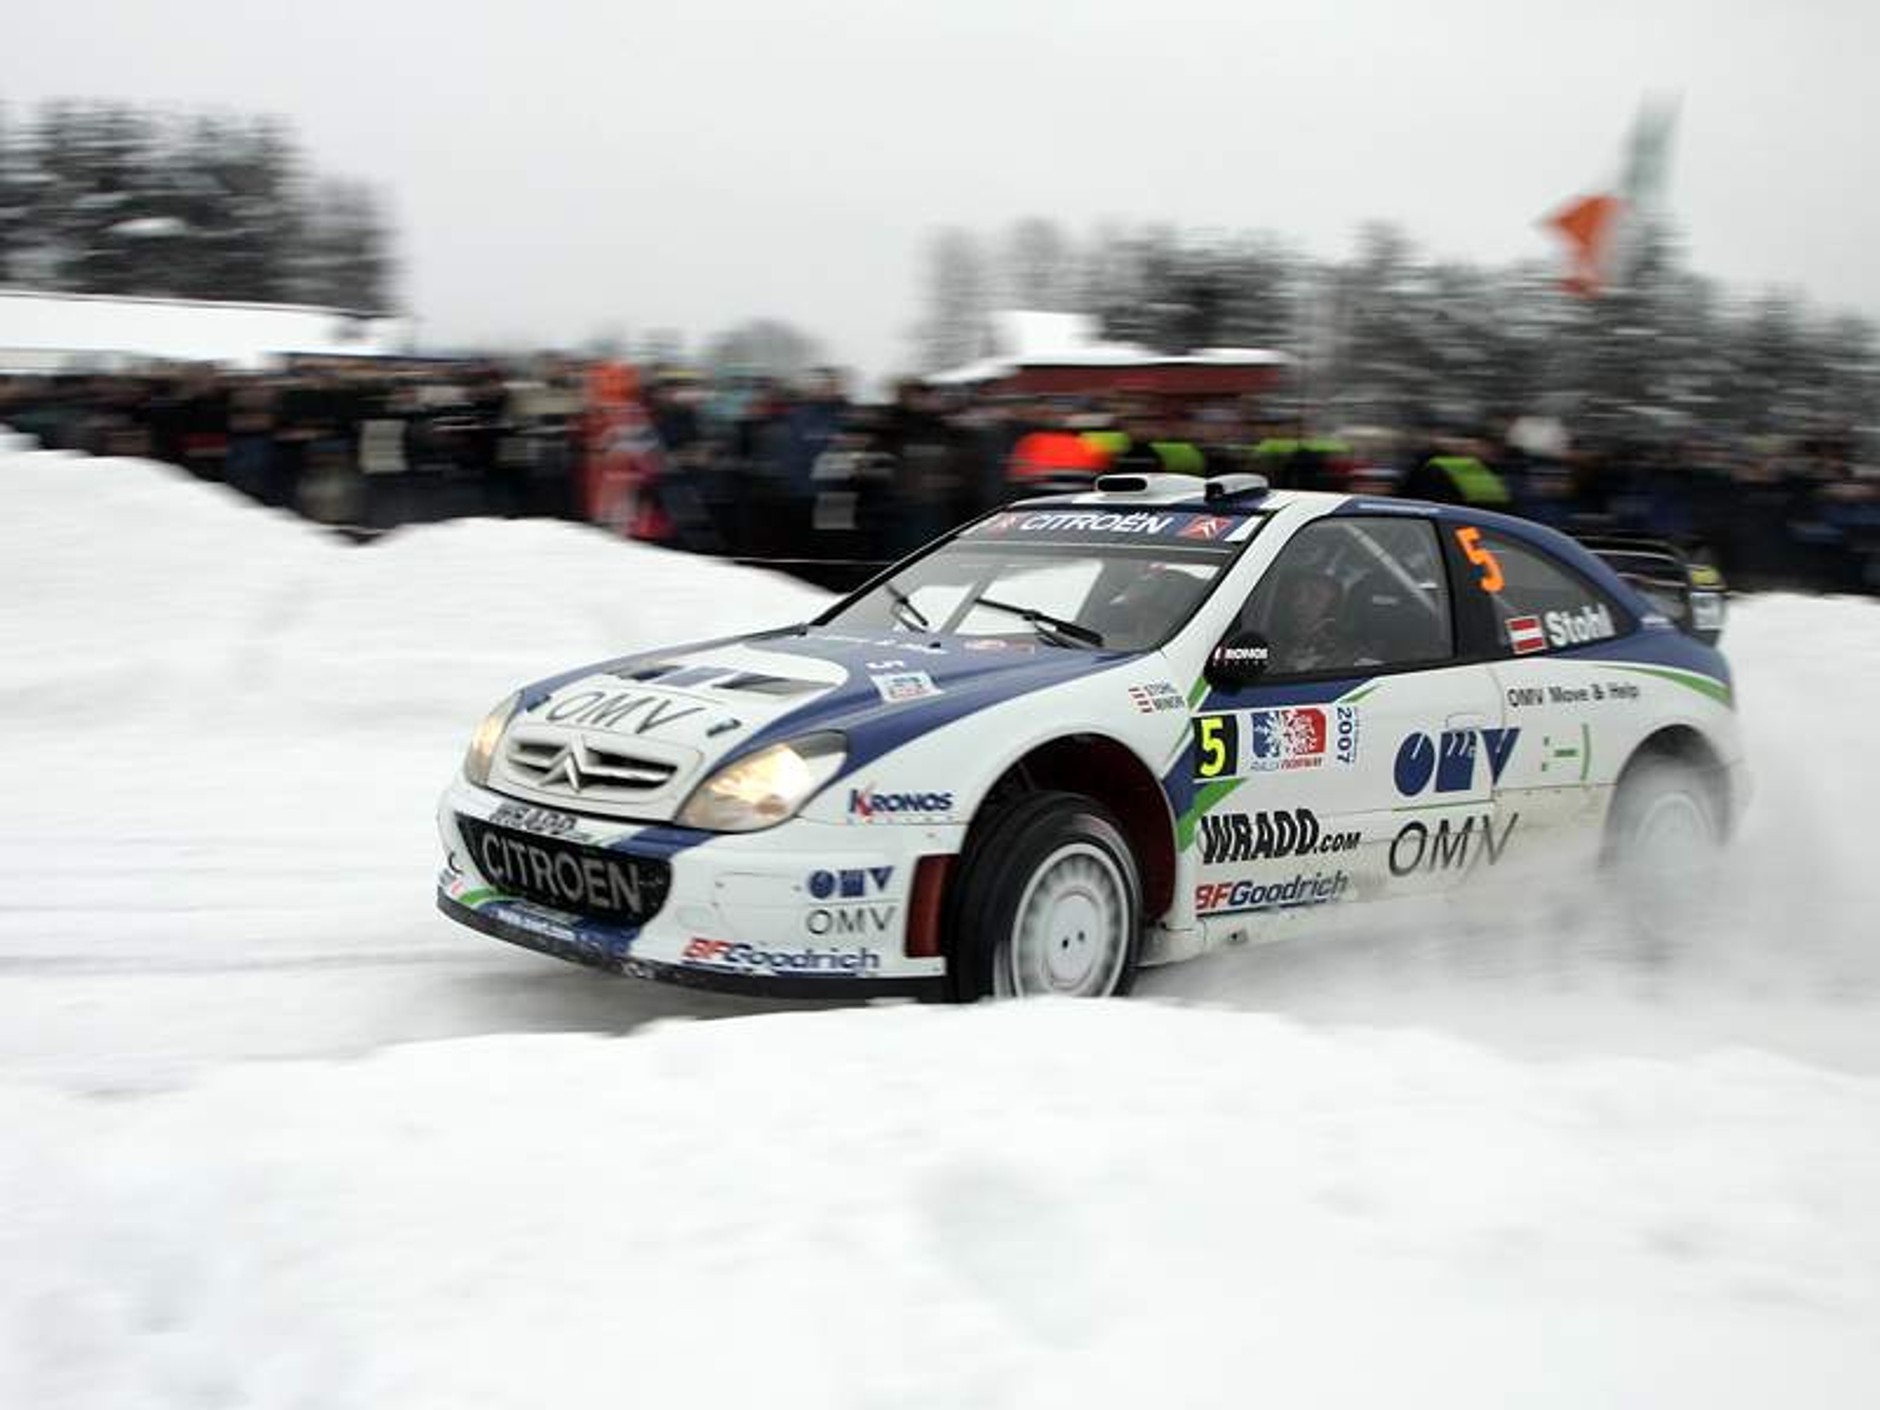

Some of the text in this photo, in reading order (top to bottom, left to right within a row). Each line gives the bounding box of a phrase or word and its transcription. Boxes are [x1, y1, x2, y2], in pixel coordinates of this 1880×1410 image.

[1020, 510, 1174, 533] CITROËN
[1455, 526, 1505, 592] 5
[1544, 604, 1616, 647] Stohl
[545, 691, 705, 735] OMV
[1506, 681, 1640, 707] OMV Move & Help
[1200, 717, 1227, 778] 5
[1336, 706, 1353, 764] 2007
[849, 782, 953, 817] KRONOS
[1388, 812, 1519, 877] OMV
[1196, 869, 1349, 911] BFGoodrich
[806, 905, 896, 935] OMV
[682, 936, 880, 969] BFGoodrich
